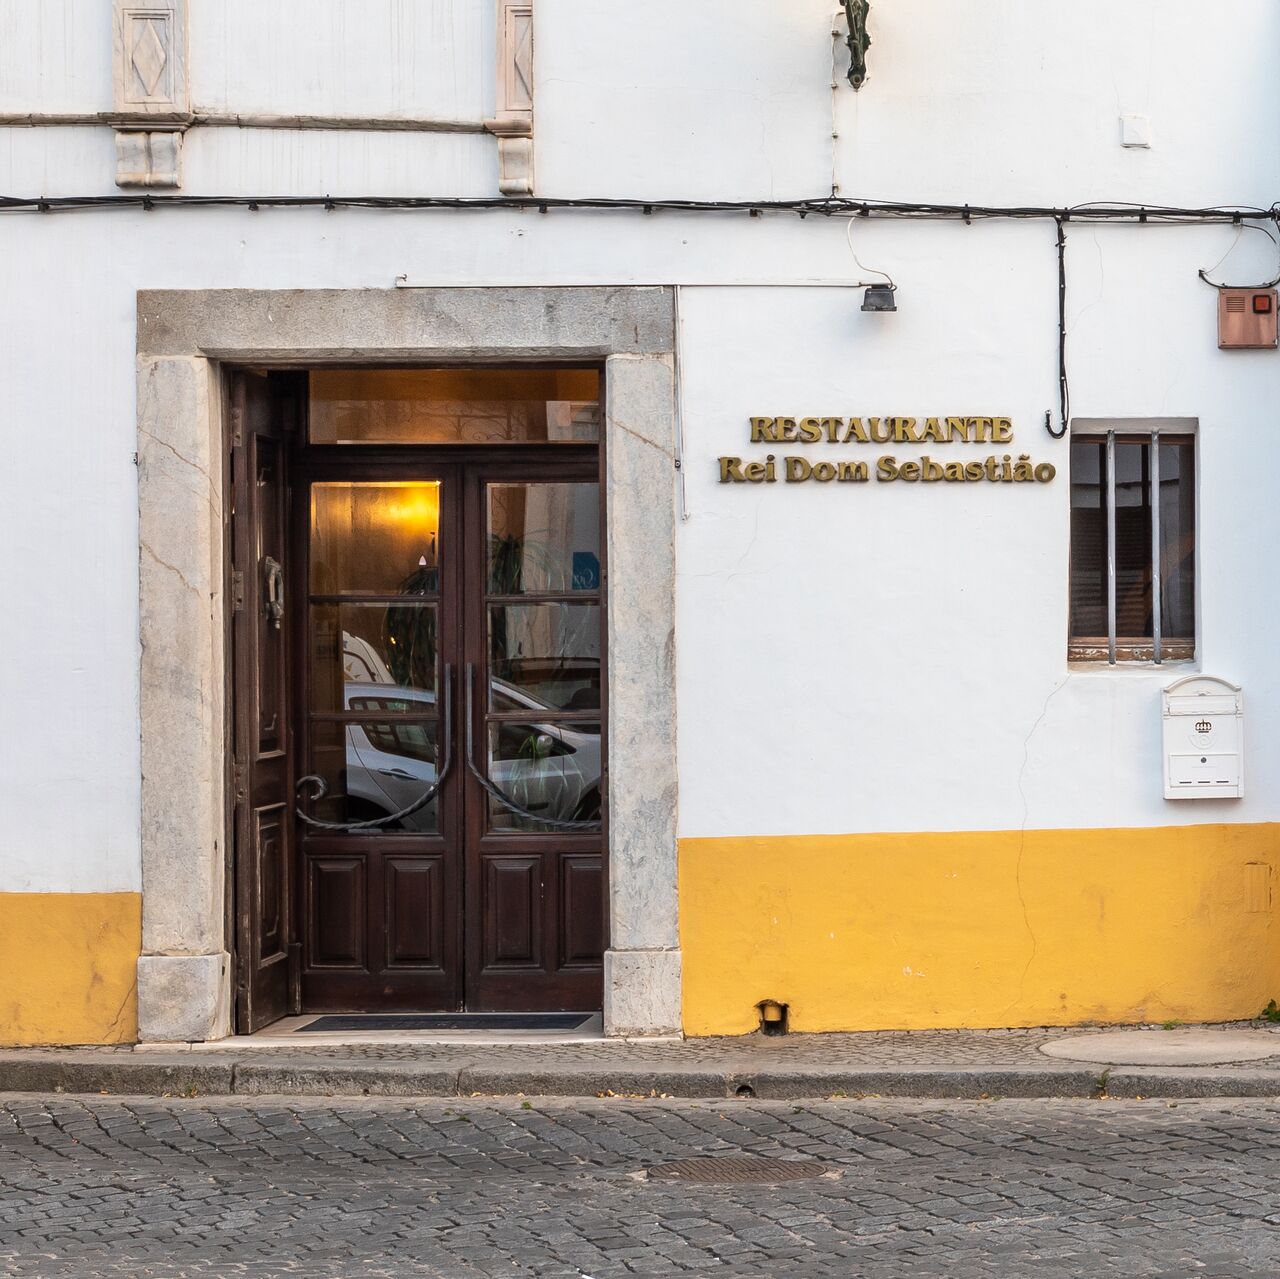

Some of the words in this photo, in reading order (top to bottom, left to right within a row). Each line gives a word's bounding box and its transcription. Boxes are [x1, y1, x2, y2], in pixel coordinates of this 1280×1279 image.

[749, 416, 1014, 444] RESTAURANTE
[718, 454, 777, 483] Rei
[784, 456, 869, 483] Dom
[875, 453, 1057, 483] Sebastião
